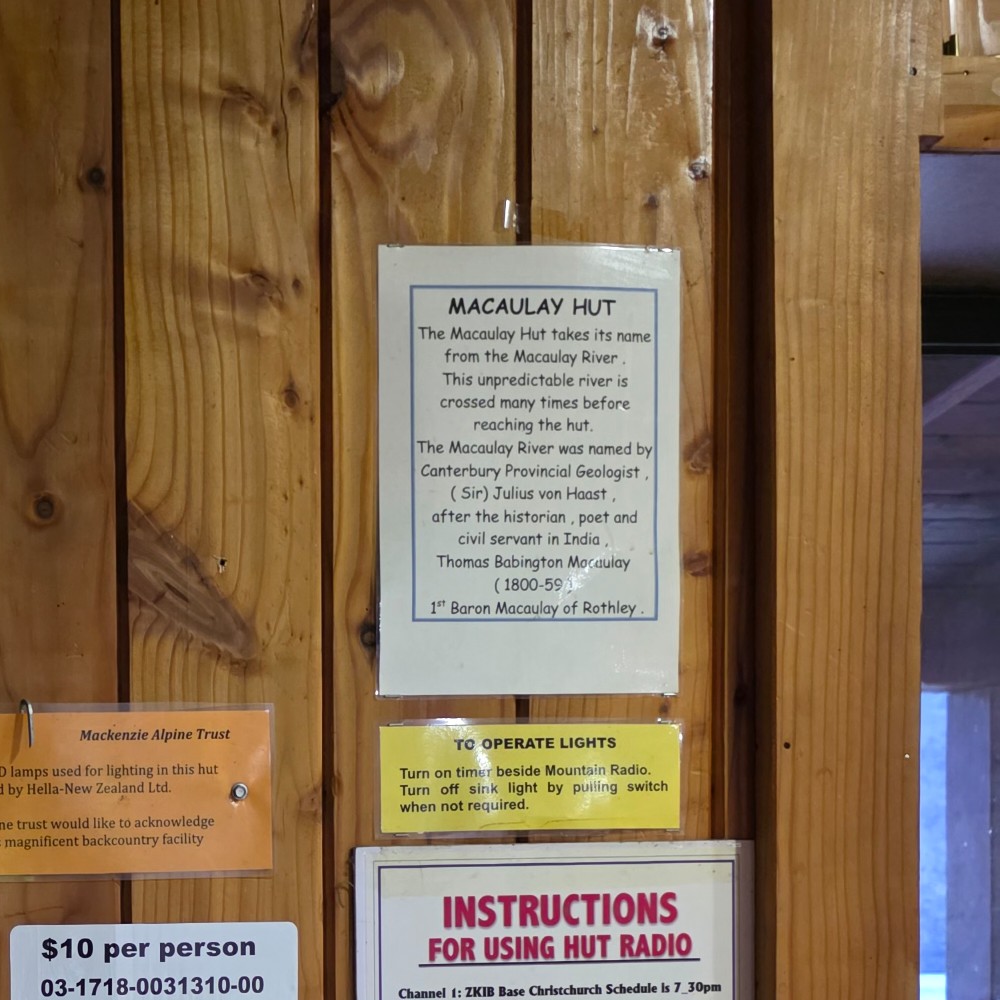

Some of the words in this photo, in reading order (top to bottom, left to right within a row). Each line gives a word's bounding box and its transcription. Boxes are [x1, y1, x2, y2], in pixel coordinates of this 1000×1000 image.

[448, 297, 564, 315] MACAULAY
[573, 298, 616, 316] HUT
[418, 326, 445, 340] The
[450, 326, 515, 344] Macaulay
[520, 326, 546, 340] Hut
[551, 326, 590, 341] takes
[595, 328, 612, 342] its
[617, 332, 651, 343] name
[442, 372, 473, 386] This
[478, 372, 574, 390] unpredictable
[579, 374, 612, 387] river
[618, 374, 628, 388] is
[440, 394, 495, 408] crossed
[500, 398, 536, 413] many
[540, 396, 578, 409] times
[583, 396, 630, 410] before
[416, 440, 444, 454] The
[449, 440, 513, 458] Macaulay
[518, 441, 554, 454] River
[559, 444, 584, 455] was
[589, 442, 632, 455] named
[637, 442, 652, 459] by
[451, 602, 491, 615] Baron
[496, 601, 559, 618] Macaulay
[563, 601, 578, 615] of
[583, 601, 637, 618] Rothley
[80, 729, 148, 741] Mackenzie
[151, 728, 192, 743] Alpine
[196, 728, 230, 740] Trust
[454, 739, 475, 750] TO
[481, 738, 554, 750] OPERATE
[560, 737, 616, 748] LIGHTS
[400, 768, 430, 779] Turn
[434, 770, 451, 778] on
[456, 765, 492, 778] timer
[496, 765, 540, 777] beside
[546, 764, 606, 776] Mountain
[610, 764, 651, 775] Radio.
[8, 783, 24, 798] by
[27, 783, 92, 795] Hella-New
[96, 782, 144, 794] Zealand
[149, 781, 171, 793] Ltd.
[400, 801, 436, 812] when
[441, 800, 464, 812] not
[468, 798, 529, 813] required.
[444, 892, 678, 929] INSTRUCTIONS
[42, 938, 93, 962] $10
[104, 942, 150, 963] per
[160, 941, 256, 962] person
[429, 938, 475, 962] FOR
[484, 936, 554, 960] USING
[564, 935, 611, 959] HUT
[620, 933, 692, 958] RADIO
[41, 976, 264, 997] 03-1718-0031310-00
[398, 988, 446, 999] Channel
[452, 988, 461, 998] 1:
[499, 986, 525, 997] Base
[529, 984, 602, 996] Christchurch
[606, 983, 657, 994] Schedule
[661, 982, 670, 993] is
